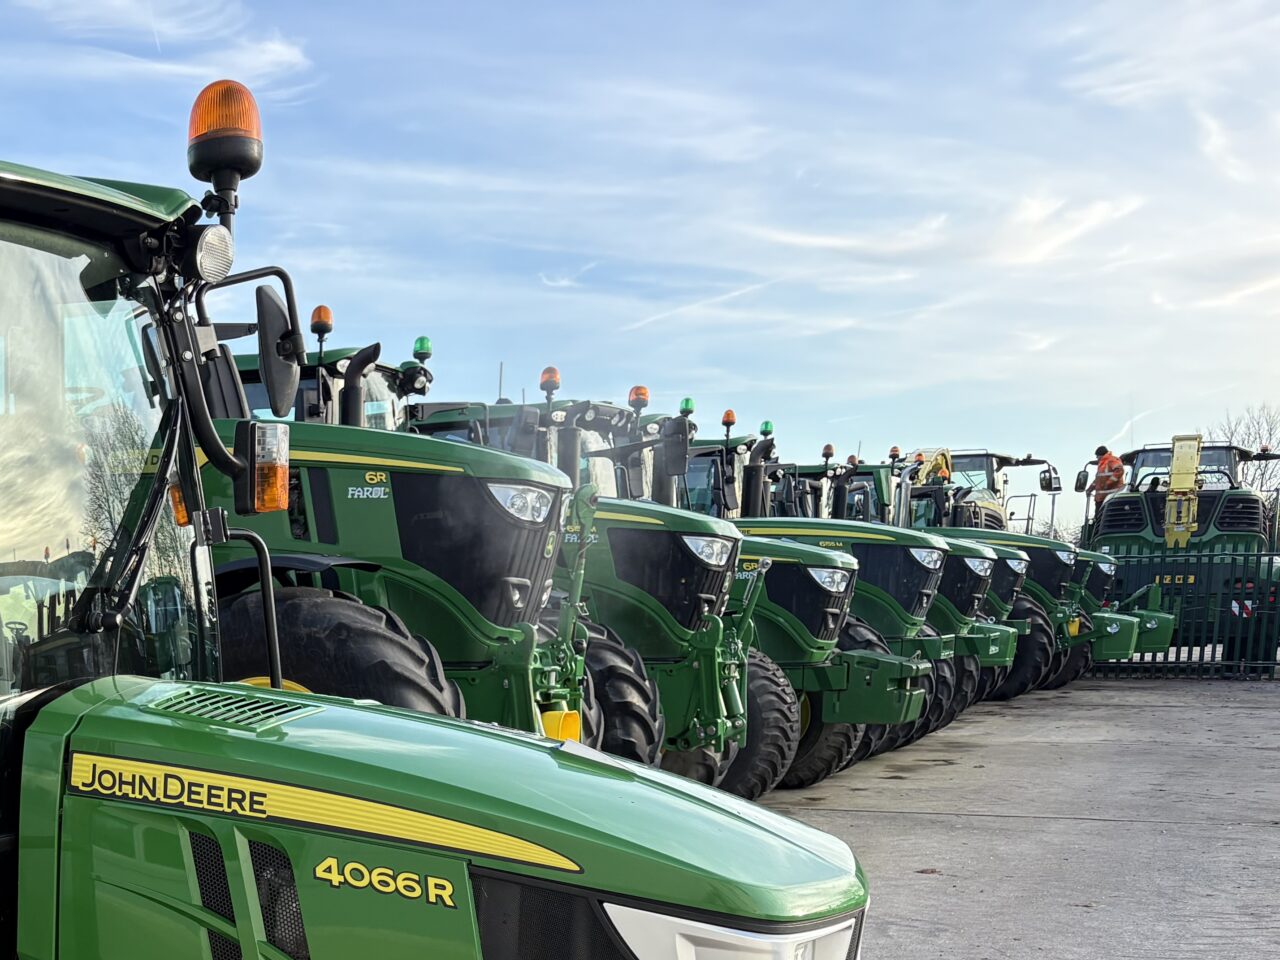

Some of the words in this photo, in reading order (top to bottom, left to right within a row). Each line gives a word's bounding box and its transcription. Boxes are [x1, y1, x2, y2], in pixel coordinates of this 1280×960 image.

[364, 471, 387, 484] 6R
[347, 486, 389, 499] FAROL
[81, 763, 158, 798] JOHN
[163, 772, 268, 815] DEERE
